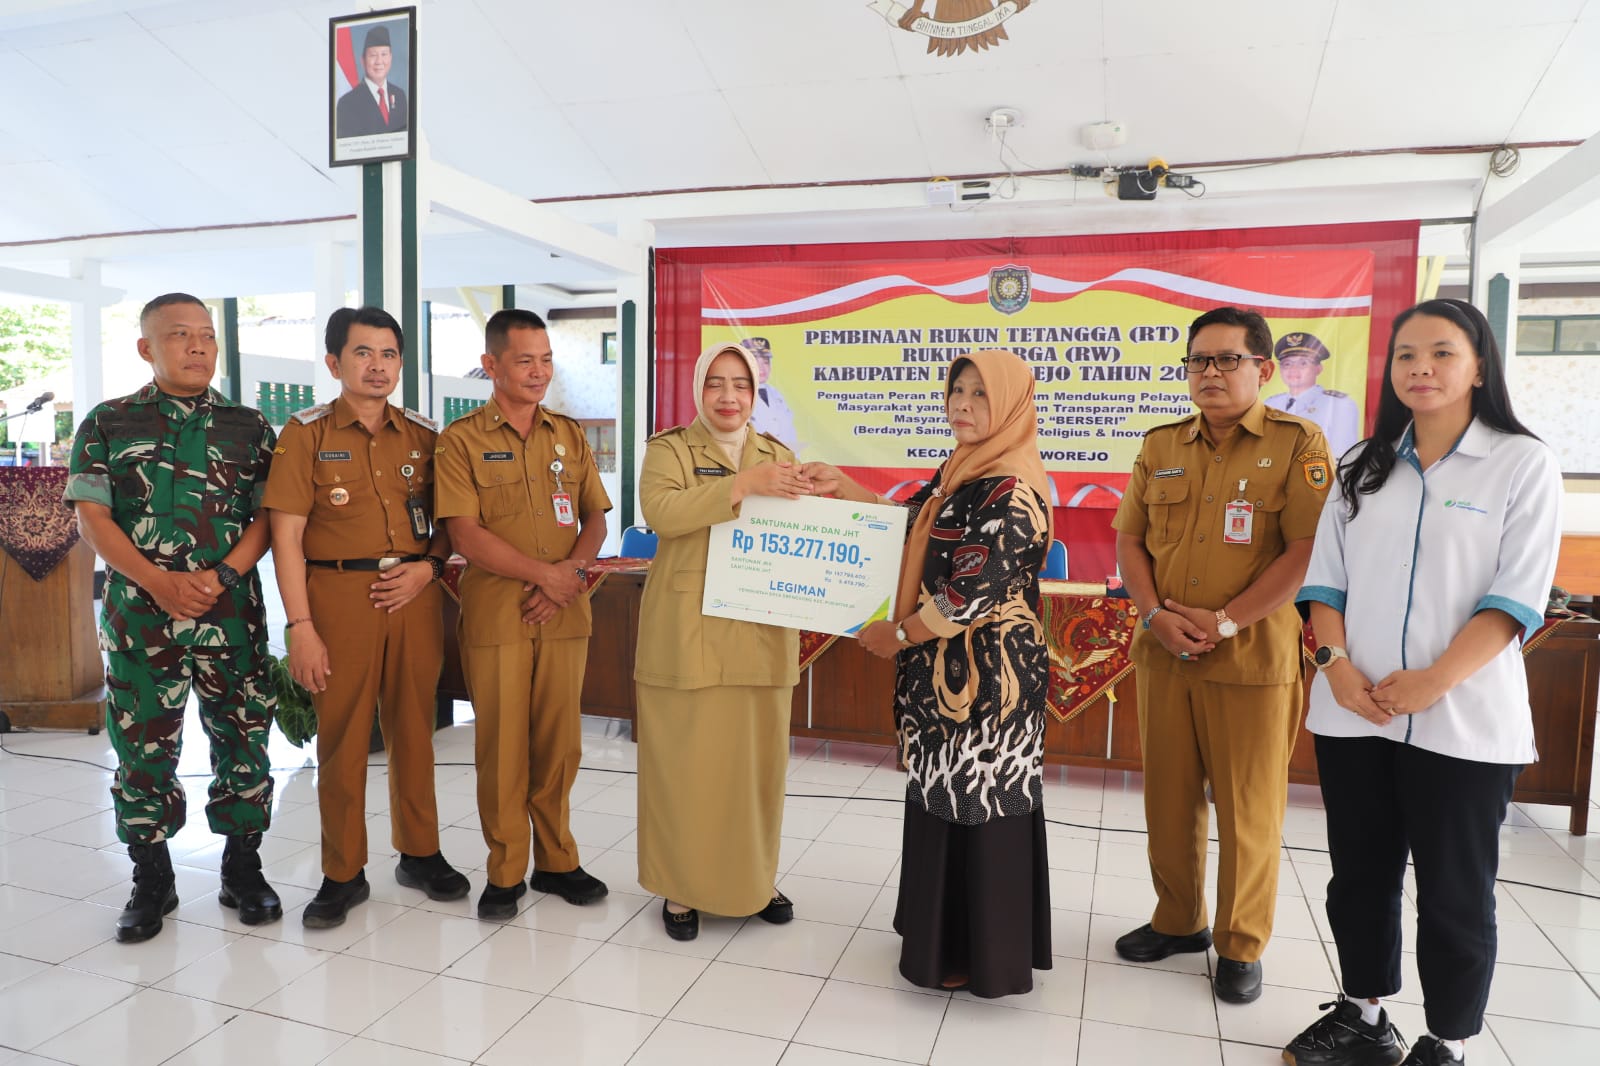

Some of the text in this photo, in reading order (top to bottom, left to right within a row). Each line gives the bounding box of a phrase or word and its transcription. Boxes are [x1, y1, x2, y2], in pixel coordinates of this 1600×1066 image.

[916, 6, 1011, 36] BHINNEKA TUNGGAL IKA
[805, 329, 922, 345] PEMBINAAN
[929, 328, 998, 343] RUKUN
[1006, 326, 1121, 342] TETANGGA
[1129, 326, 1180, 343] (RT)
[979, 347, 1058, 362] RGA
[1065, 346, 1121, 363] (RW)
[814, 366, 930, 381] KABUPATEN
[1079, 366, 1152, 381] TAHUN
[1159, 366, 1188, 381] 20
[817, 391, 884, 401] Penguatan
[888, 391, 926, 400] Peran
[1054, 392, 1136, 403] Mendukung
[1140, 392, 1192, 403] Pelaya
[837, 402, 913, 413] Masyarakat
[1053, 404, 1134, 415] Transparan
[1138, 405, 1191, 416] Menuju
[894, 414, 949, 425] Masyara
[854, 426, 911, 437] (Berdaya
[1037, 427, 1091, 438] Religius
[1095, 428, 1106, 437] &
[1040, 451, 1109, 461] WOREJO
[750, 517, 860, 538] SANTUNAN JKK DAN JHT
[732, 528, 871, 568] Rp 153.277.190,-
[769, 580, 826, 598] LEGIMAN
